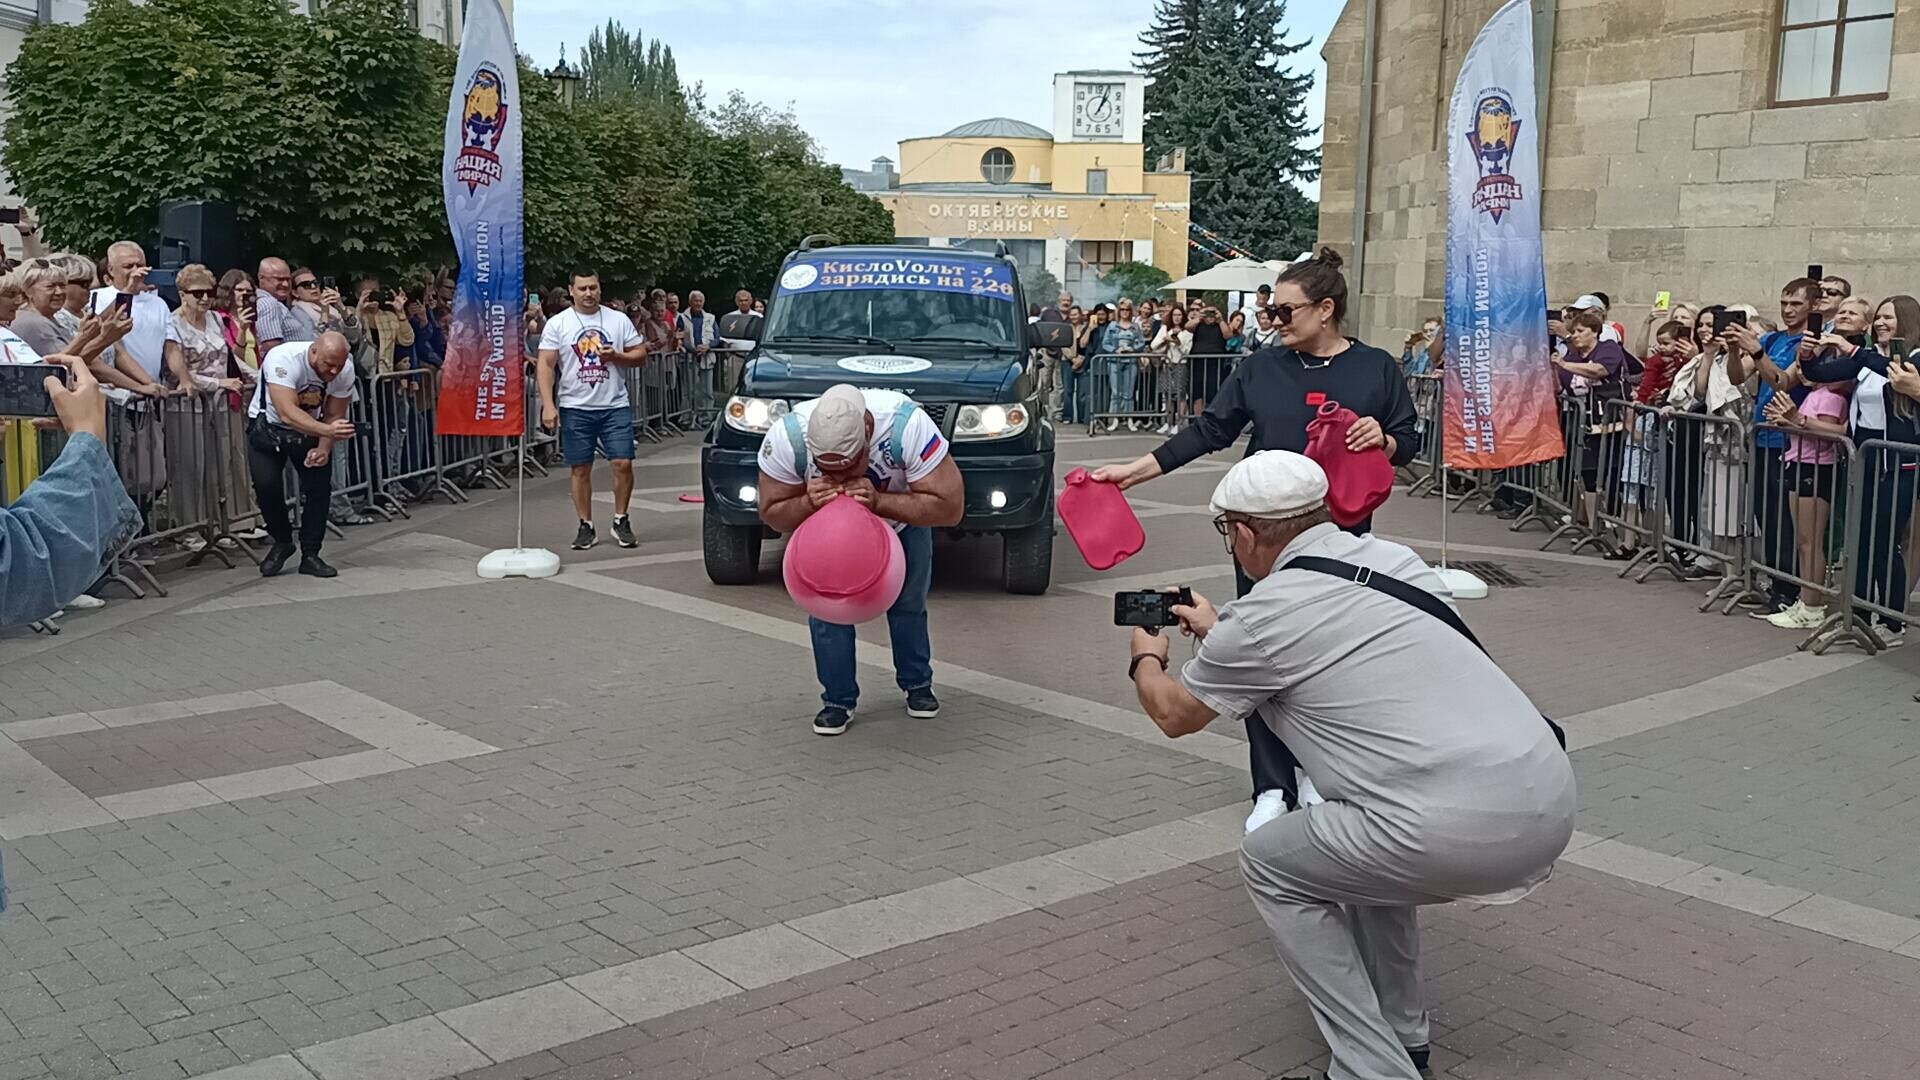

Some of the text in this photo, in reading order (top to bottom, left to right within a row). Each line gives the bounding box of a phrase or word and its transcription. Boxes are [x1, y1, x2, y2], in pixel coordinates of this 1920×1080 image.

[1095, 84, 1103, 94] 12
[1077, 91, 1085, 101] 10
[1115, 91, 1121, 101] 2
[1076, 105, 1082, 114] 9
[1114, 105, 1121, 114] 3
[1076, 118, 1082, 127] 8
[1114, 118, 1120, 127] 4
[1086, 124, 1091, 133] 7
[1095, 124, 1101, 133] 6
[1105, 124, 1111, 133] 5
[455, 154, 501, 179] НАЦИЯ
[458, 169, 489, 184] МИРА
[928, 203, 1069, 219] ОКТЯБРЬСКИЕ
[968, 219, 1033, 233] ВАННЫ
[477, 221, 489, 283] NATION
[820, 274, 931, 287] зарядись
[937, 277, 964, 287] на
[491, 304, 505, 363] WORLD
[492, 367, 506, 398] THE
[475, 386, 488, 420] THE
[490, 402, 505, 420] IN
